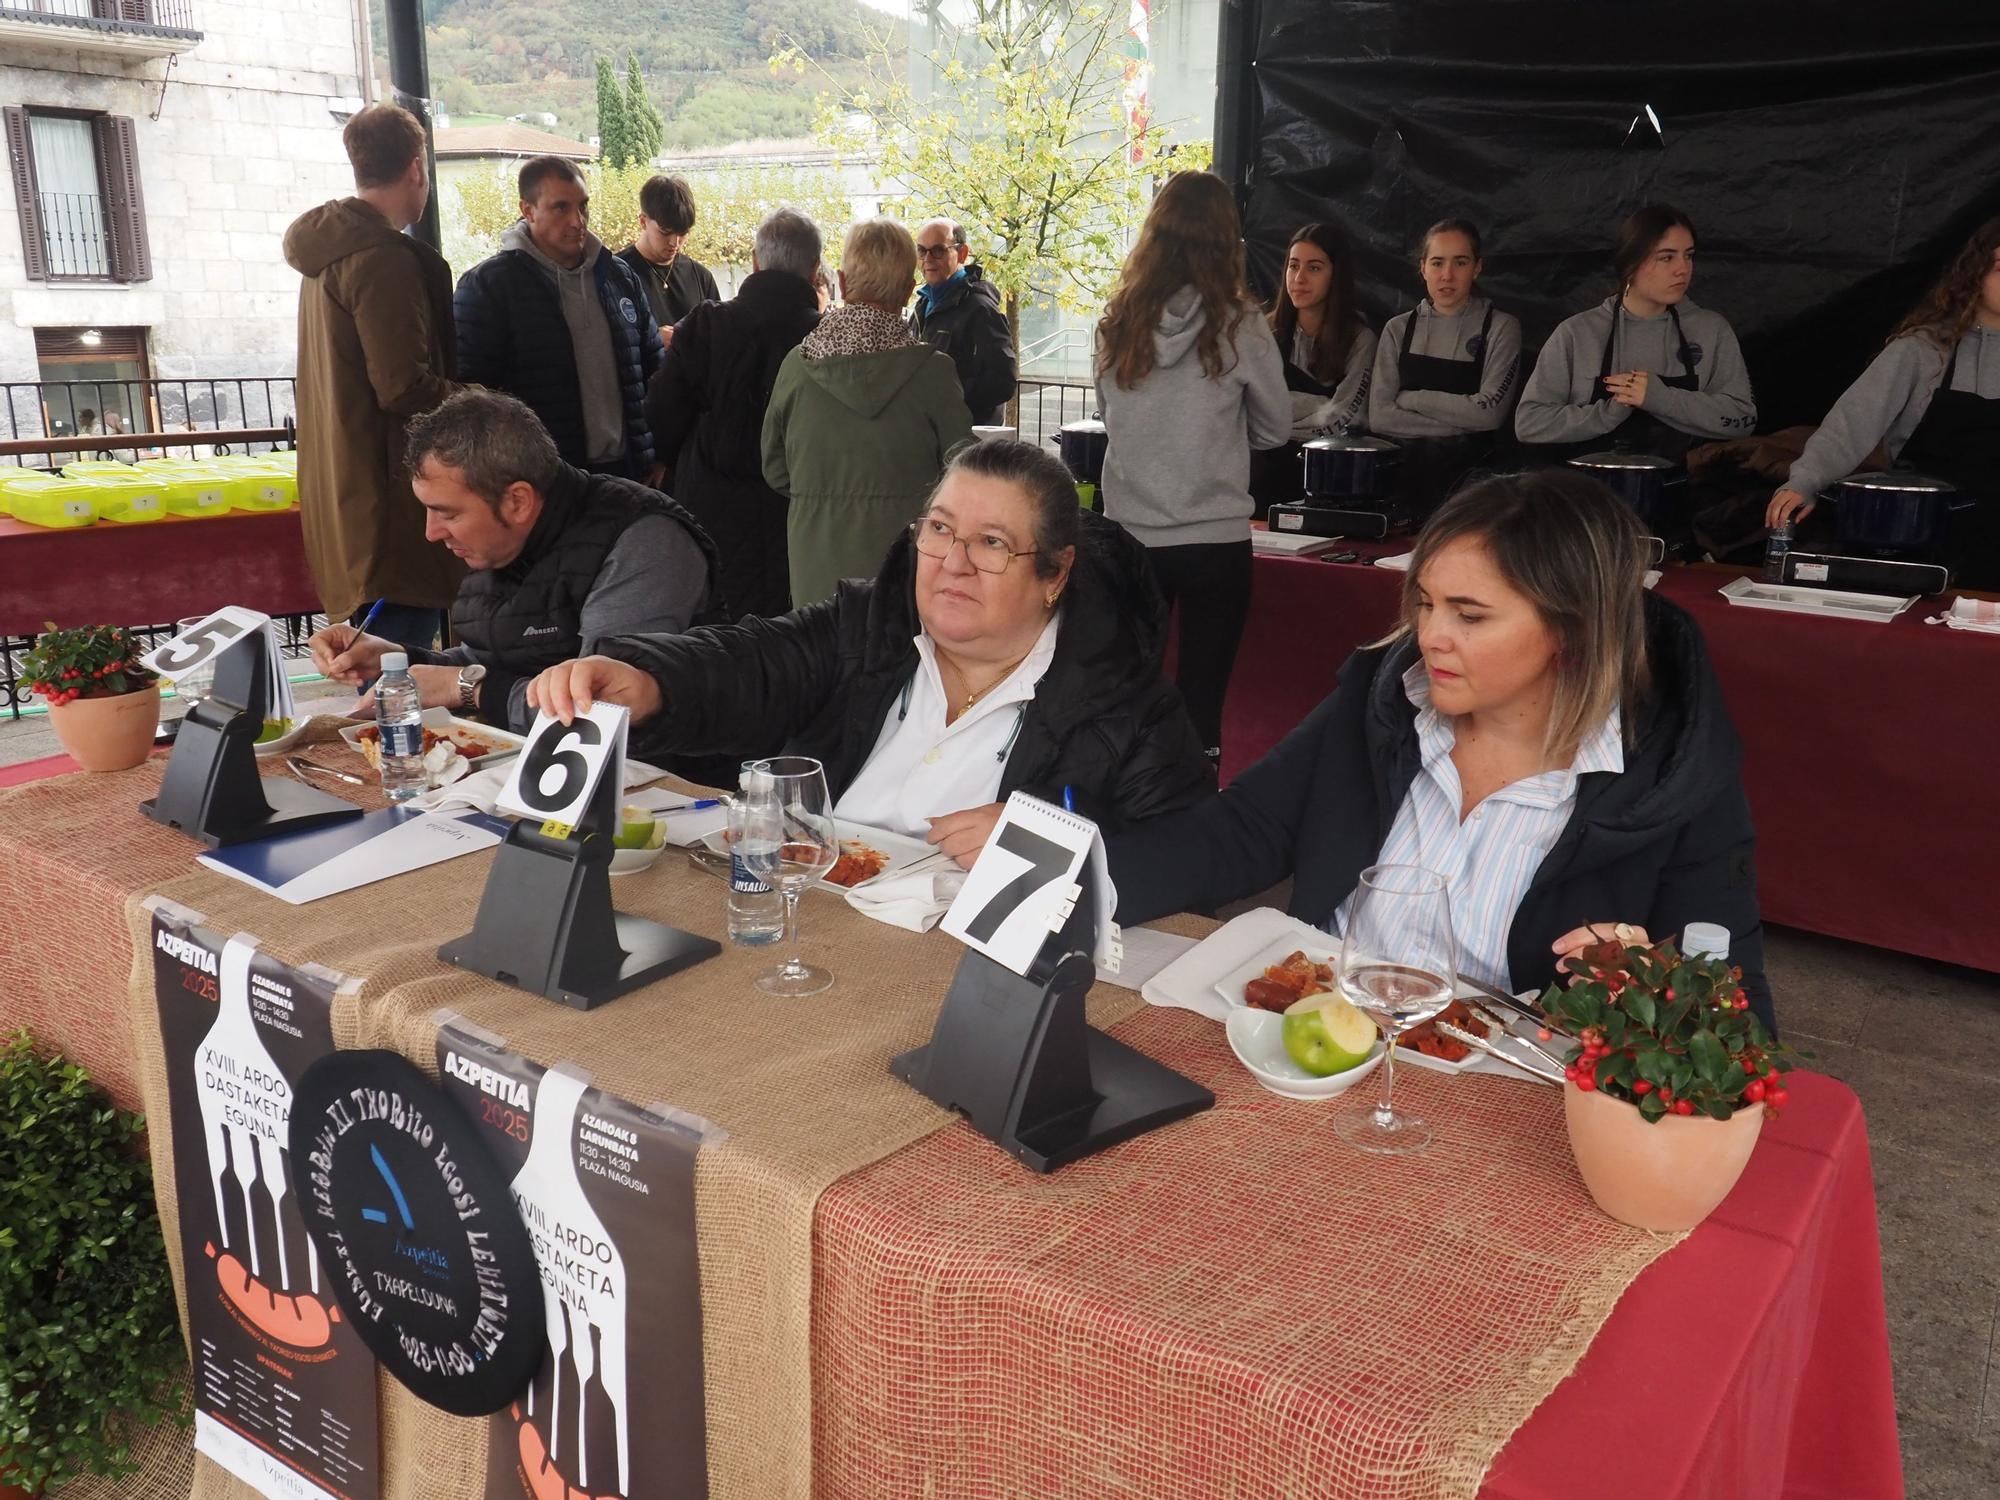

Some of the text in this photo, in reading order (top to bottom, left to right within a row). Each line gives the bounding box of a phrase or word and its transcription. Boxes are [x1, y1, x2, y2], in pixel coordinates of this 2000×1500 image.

[154, 617, 245, 672] 5
[518, 716, 602, 813] 6
[964, 820, 1077, 945] 7
[156, 929, 217, 976] AZPEITIA
[180, 967, 218, 1002] 2025
[204, 1046, 286, 1098] XVIII. ARDO
[444, 1051, 531, 1112] AZPEITIA
[206, 1071, 290, 1122] DASTAKETA
[224, 1104, 278, 1143] EGUNA
[481, 1097, 528, 1143] 2025
[581, 1113, 638, 1146] AZAROAK 8
[580, 1127, 639, 1162] LARUNBATA
[607, 1154, 631, 1173] 14:30
[579, 1157, 649, 1195] PLAZA NAGUSIA
[526, 1226, 615, 1300] ASTAKETA
[554, 1222, 613, 1265] ARDO
